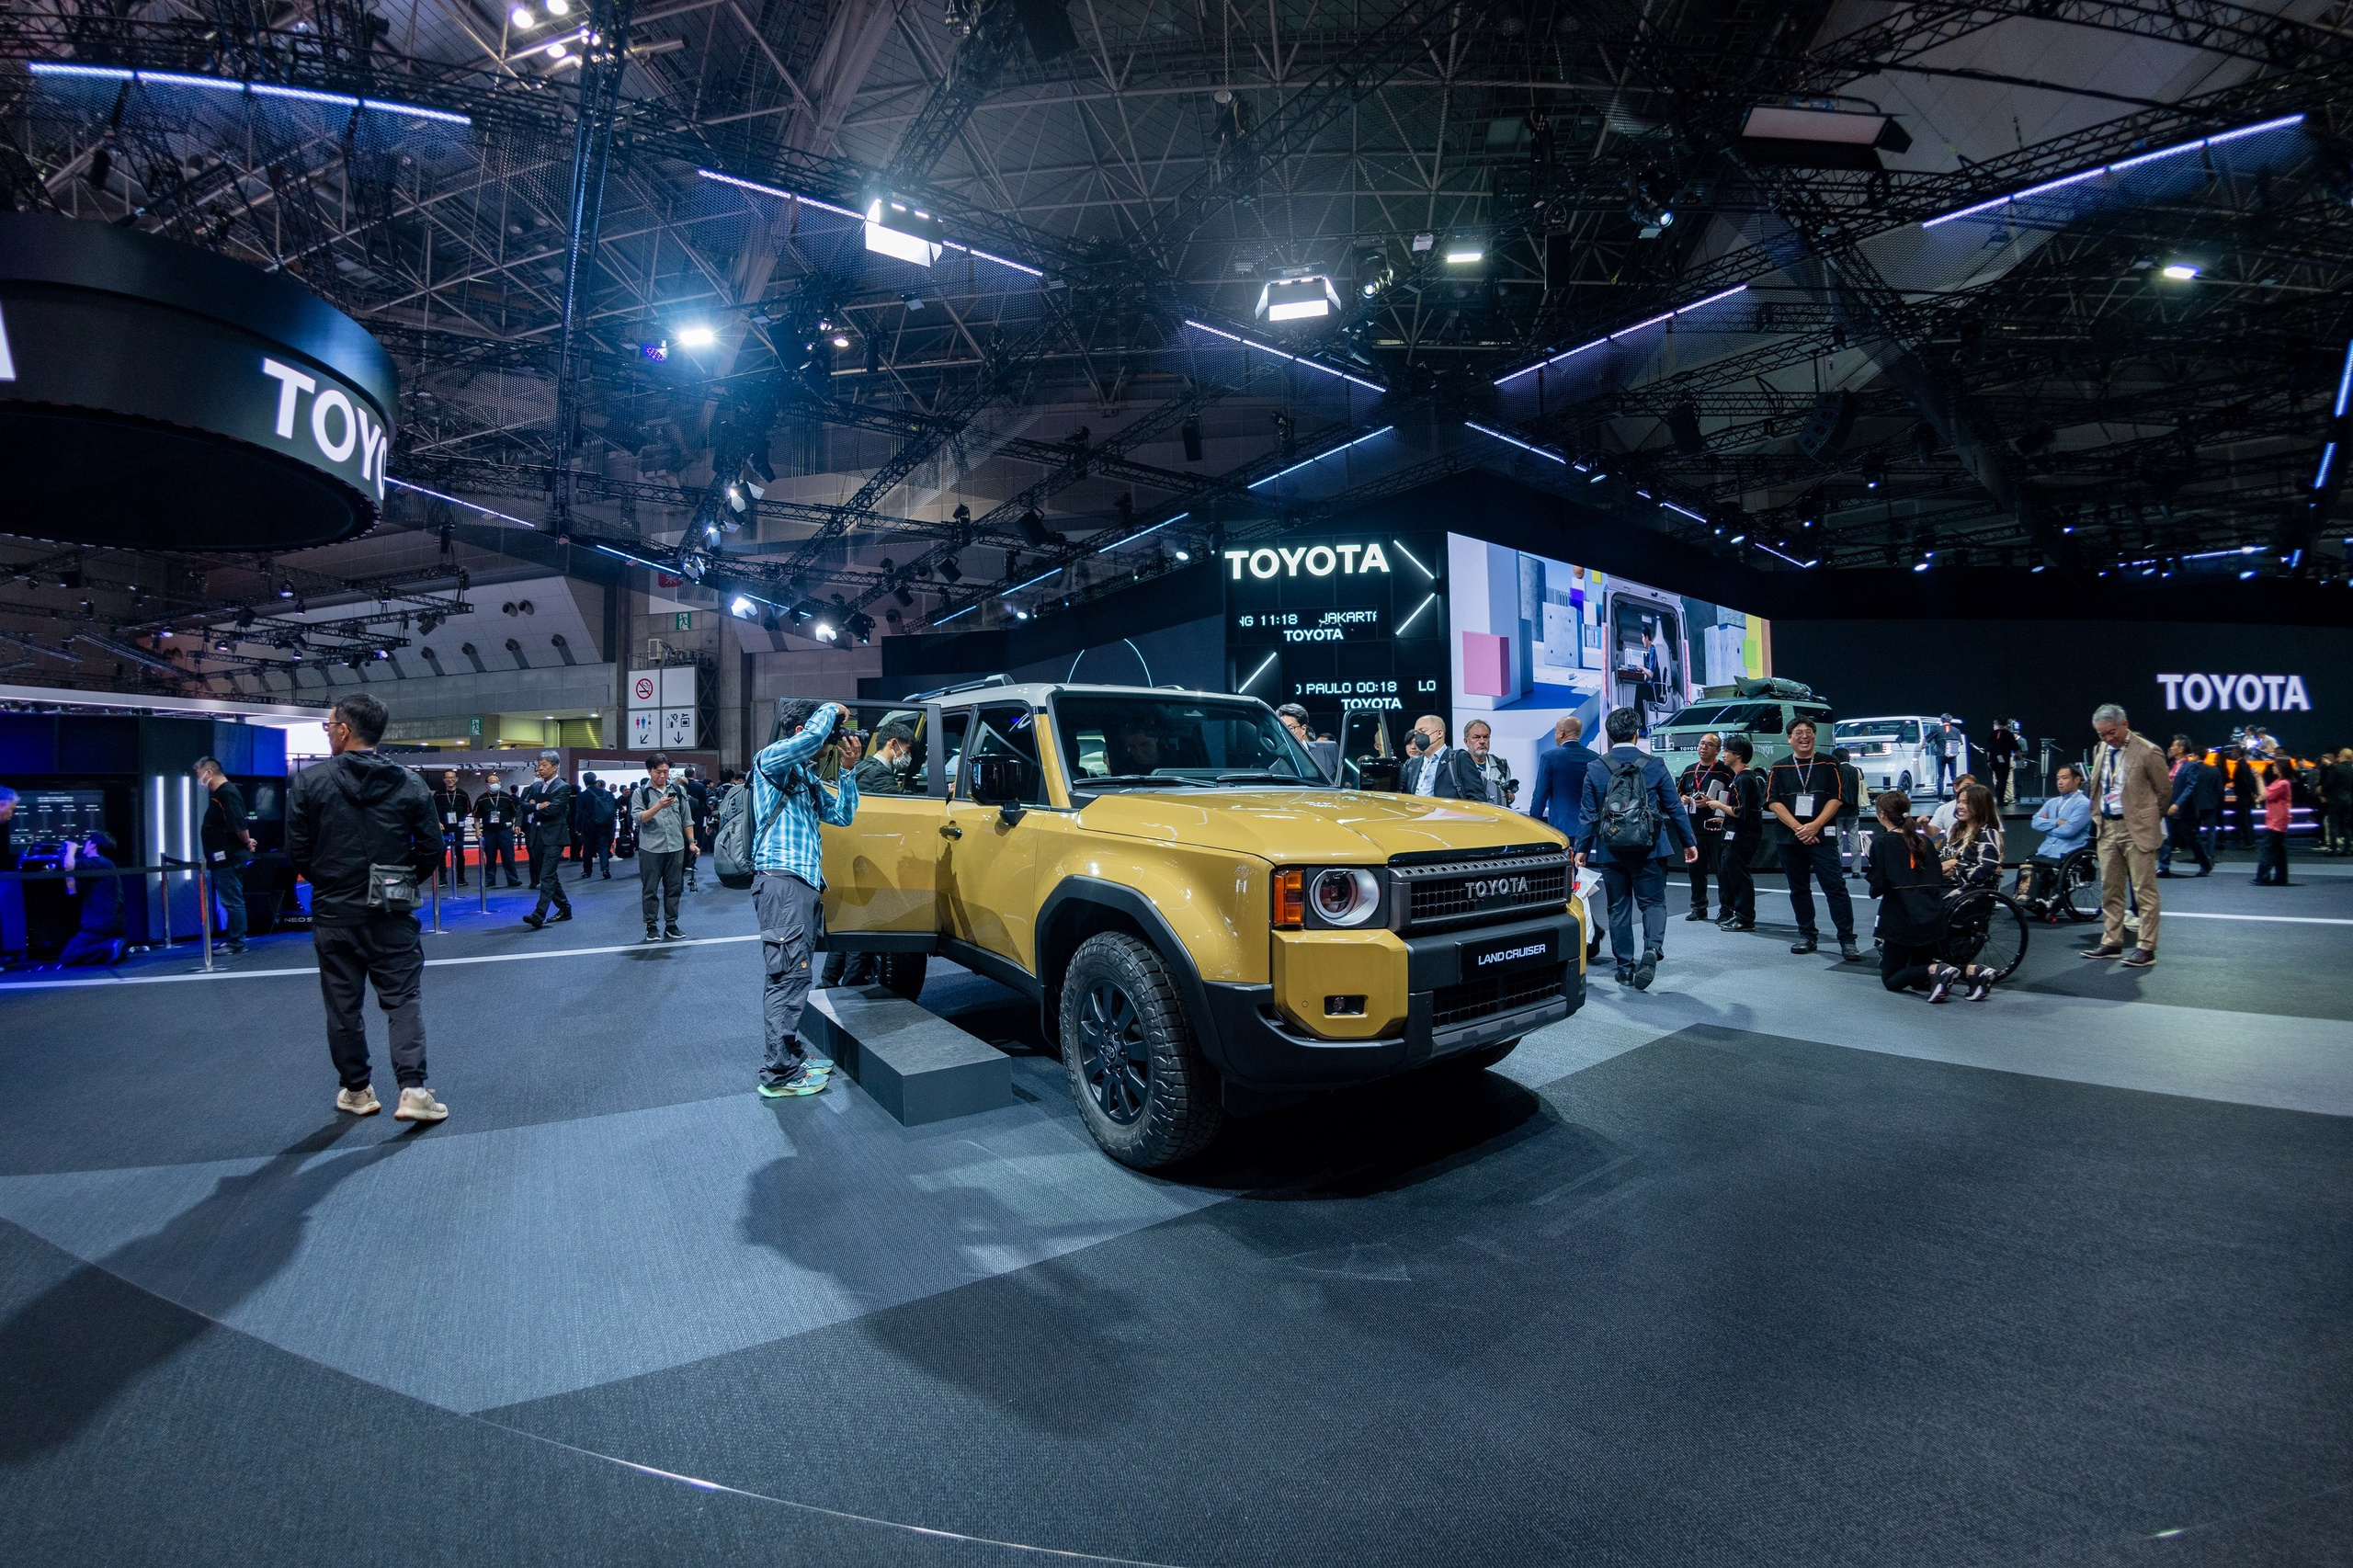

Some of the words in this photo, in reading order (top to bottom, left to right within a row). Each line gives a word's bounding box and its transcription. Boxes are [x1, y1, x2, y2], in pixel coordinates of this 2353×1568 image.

[1224, 543, 1391, 580] TOYOTA
[1261, 613, 1298, 626] 11:18
[1283, 628, 1344, 642] TOYOTA
[1306, 682, 1351, 695] PAULO
[1357, 681, 1397, 693] 00:18
[1418, 680, 1436, 692] LO
[2156, 674, 2312, 711] TOYOTA
[1341, 698, 1403, 710] TOYOTA
[1465, 877, 1529, 899] TOYOTA
[1478, 951, 1505, 966] LAND
[1506, 943, 1546, 960] CRUISER
